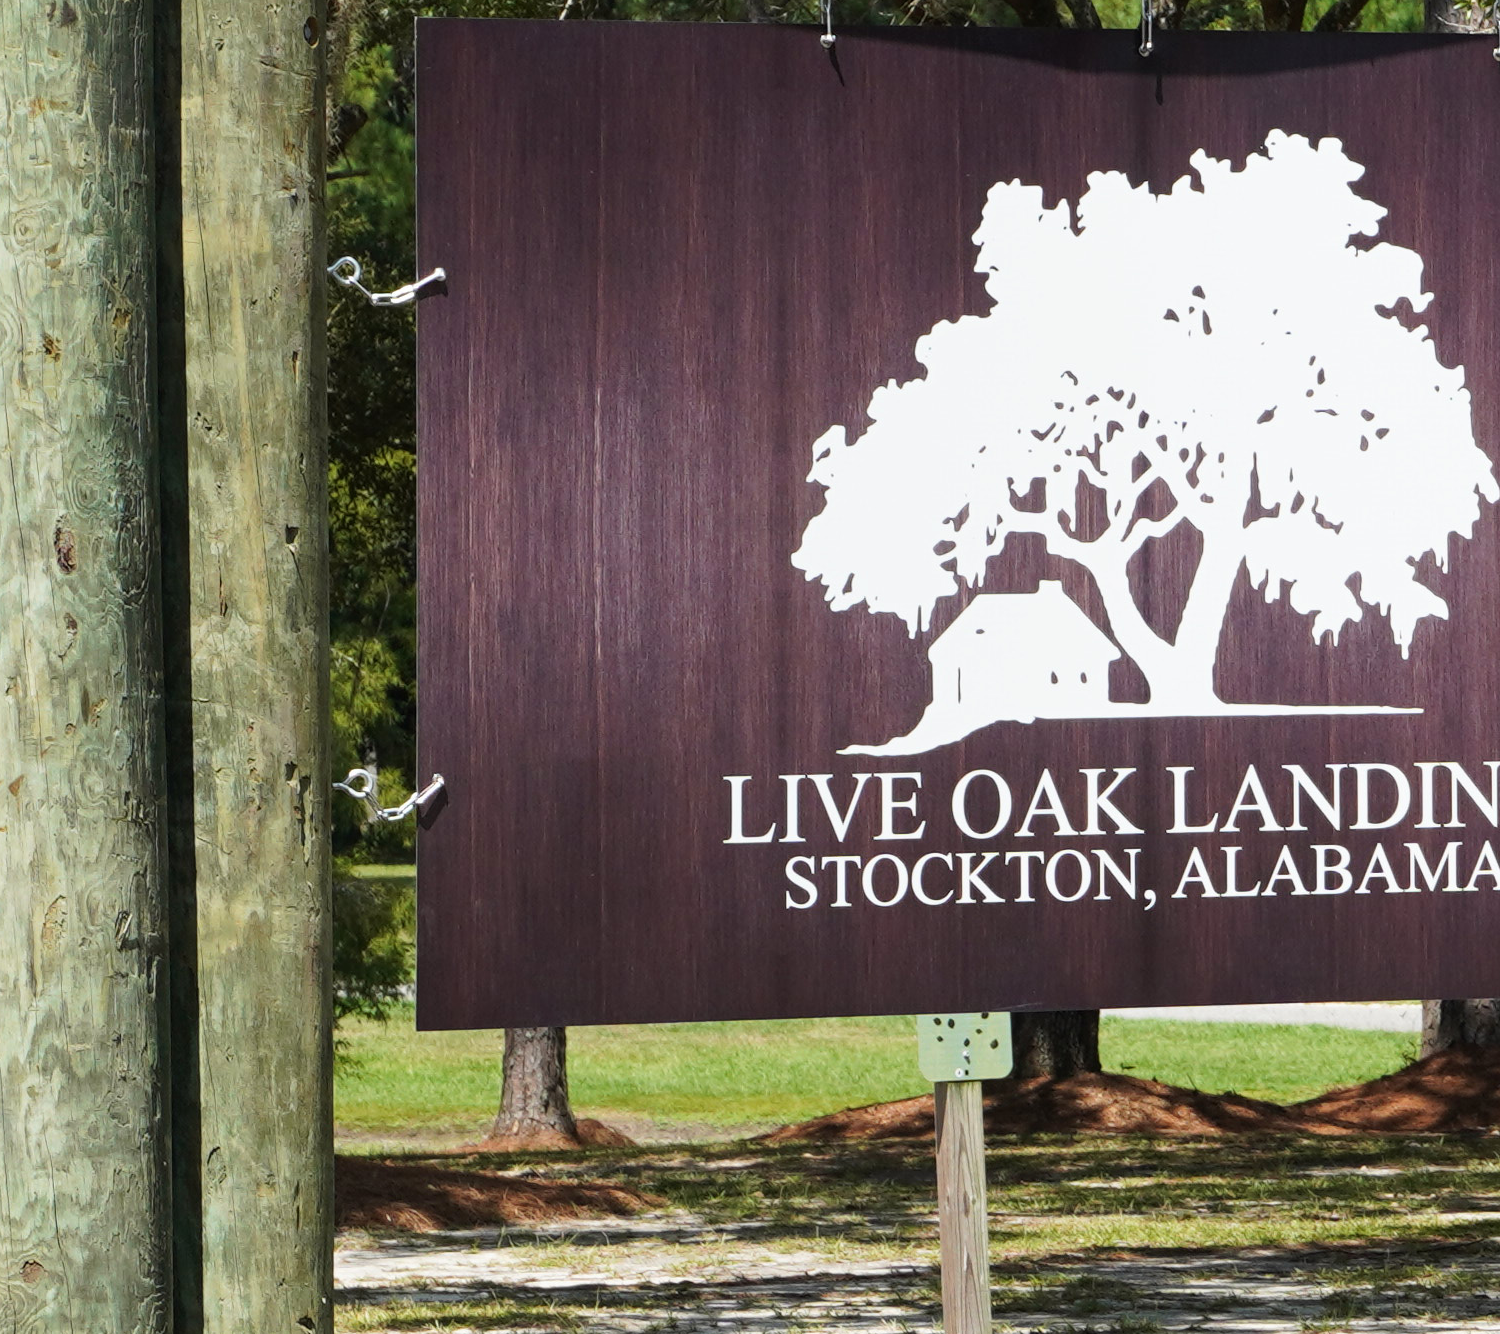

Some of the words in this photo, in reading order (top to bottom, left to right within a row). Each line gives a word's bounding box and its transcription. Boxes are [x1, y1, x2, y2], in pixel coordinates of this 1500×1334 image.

[722, 771, 927, 844] LIVE
[951, 767, 1145, 840] OAK
[785, 848, 1157, 911] STOCKTON,
